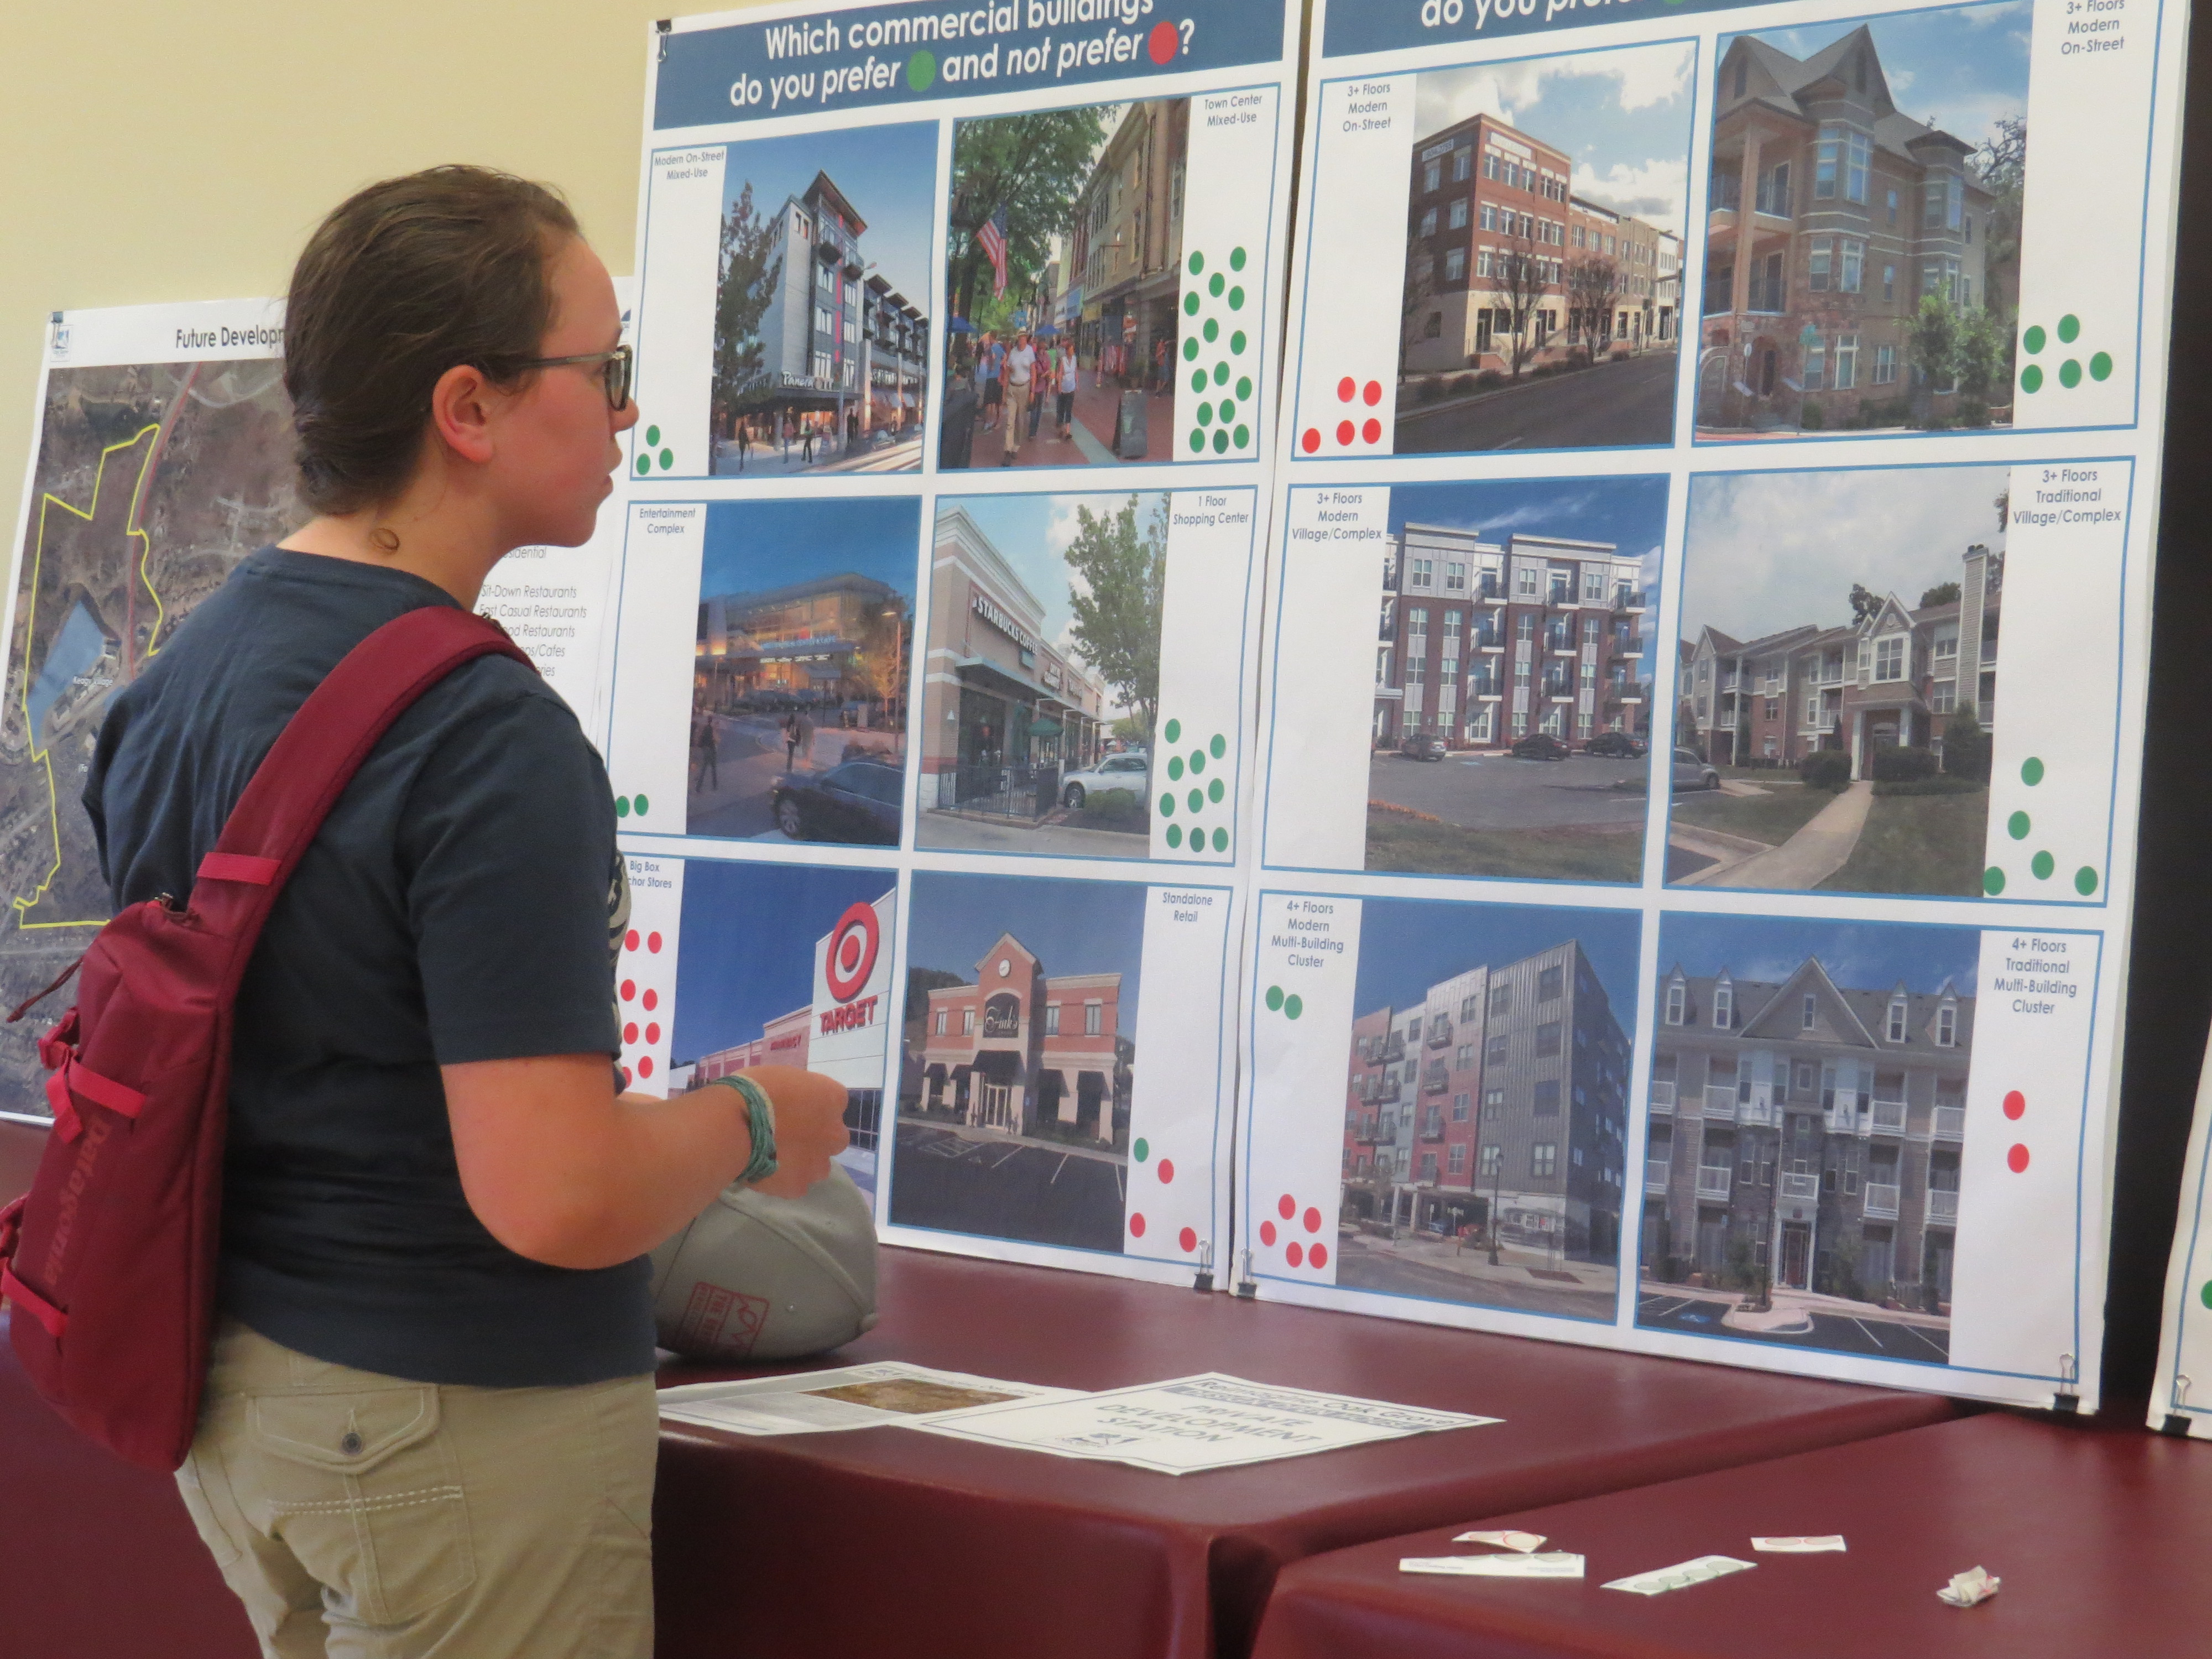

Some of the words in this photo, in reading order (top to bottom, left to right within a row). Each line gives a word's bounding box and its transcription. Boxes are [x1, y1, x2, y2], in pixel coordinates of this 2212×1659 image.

[1421, 0, 1464, 27] do
[2067, 1, 2082, 14] 3+
[2086, 0, 2125, 13] Floors
[766, 19, 839, 59] Which
[848, 0, 1018, 49] commercial
[1027, 0, 1154, 28] buildings
[2067, 19, 2120, 34] Modern
[2061, 36, 2125, 55] On-Street
[730, 73, 763, 106] do
[770, 72, 815, 109] you
[821, 56, 901, 103] prefer
[942, 43, 999, 82] and
[1006, 36, 1051, 75] not
[1057, 28, 1144, 77] prefer
[1178, 18, 1195, 54] ?
[1347, 85, 1359, 97] 3+
[1362, 82, 1391, 96] Floors
[1205, 98, 1228, 109] Town
[1230, 93, 1262, 107] Center
[1348, 100, 1387, 114] Modern
[1207, 112, 1257, 127] Mixed-Use
[1342, 117, 1391, 132] On-Street
[654, 155, 684, 166] Modern
[686, 150, 724, 163] On-Street
[666, 168, 708, 180] Mixed-Use
[176, 328, 216, 348] Future
[2042, 469, 2057, 483] 3+
[2062, 469, 2098, 482] Floors
[1205, 495, 1227, 507] Floor
[1317, 493, 1330, 504] 3+
[1333, 492, 1363, 504] Floors
[2036, 488, 2101, 503] Traditional
[639, 508, 696, 518] Entertainment
[1173, 513, 1215, 526] Shopping
[1218, 512, 1249, 524] Center
[1318, 510, 1358, 521] Modern
[2013, 508, 2121, 526] Village/Complex
[647, 523, 685, 535] Complex
[1292, 528, 1382, 542] Village/Complex
[503, 545, 547, 559] sidential
[481, 585, 521, 597] Sit-Down
[525, 585, 577, 598] Restaurants
[500, 604, 531, 617] Casual
[534, 605, 587, 618] Restaurants
[976, 595, 1019, 641] STARBUCKS
[523, 624, 575, 638] Restaurants
[630, 860, 642, 873] Big
[645, 862, 660, 872] Box
[648, 877, 672, 888] Stores
[1162, 893, 1213, 906] Standalone
[1287, 900, 1300, 912] 4+
[1303, 901, 1334, 914] Floors
[1173, 910, 1198, 922] Retail
[1287, 919, 1329, 932] Modern
[1271, 935, 1344, 954] Multi-Building
[2012, 937, 2027, 951] 4+
[2031, 938, 2067, 953] Floors
[1287, 954, 1324, 968] Cluster
[2006, 957, 2070, 973] Traditional
[1994, 978, 2077, 998] Multi-Building
[2012, 999, 2055, 1014] Cluster
[820, 995, 878, 1036] TARGET
[1182, 1405, 1312, 1427] PRIVATE
[1323, 1402, 1379, 1413] Oak
[1380, 1411, 1456, 1425] Grove
[1095, 1404, 1323, 1443] DEVELOPMENT
[1098, 1417, 1233, 1442] STATION
